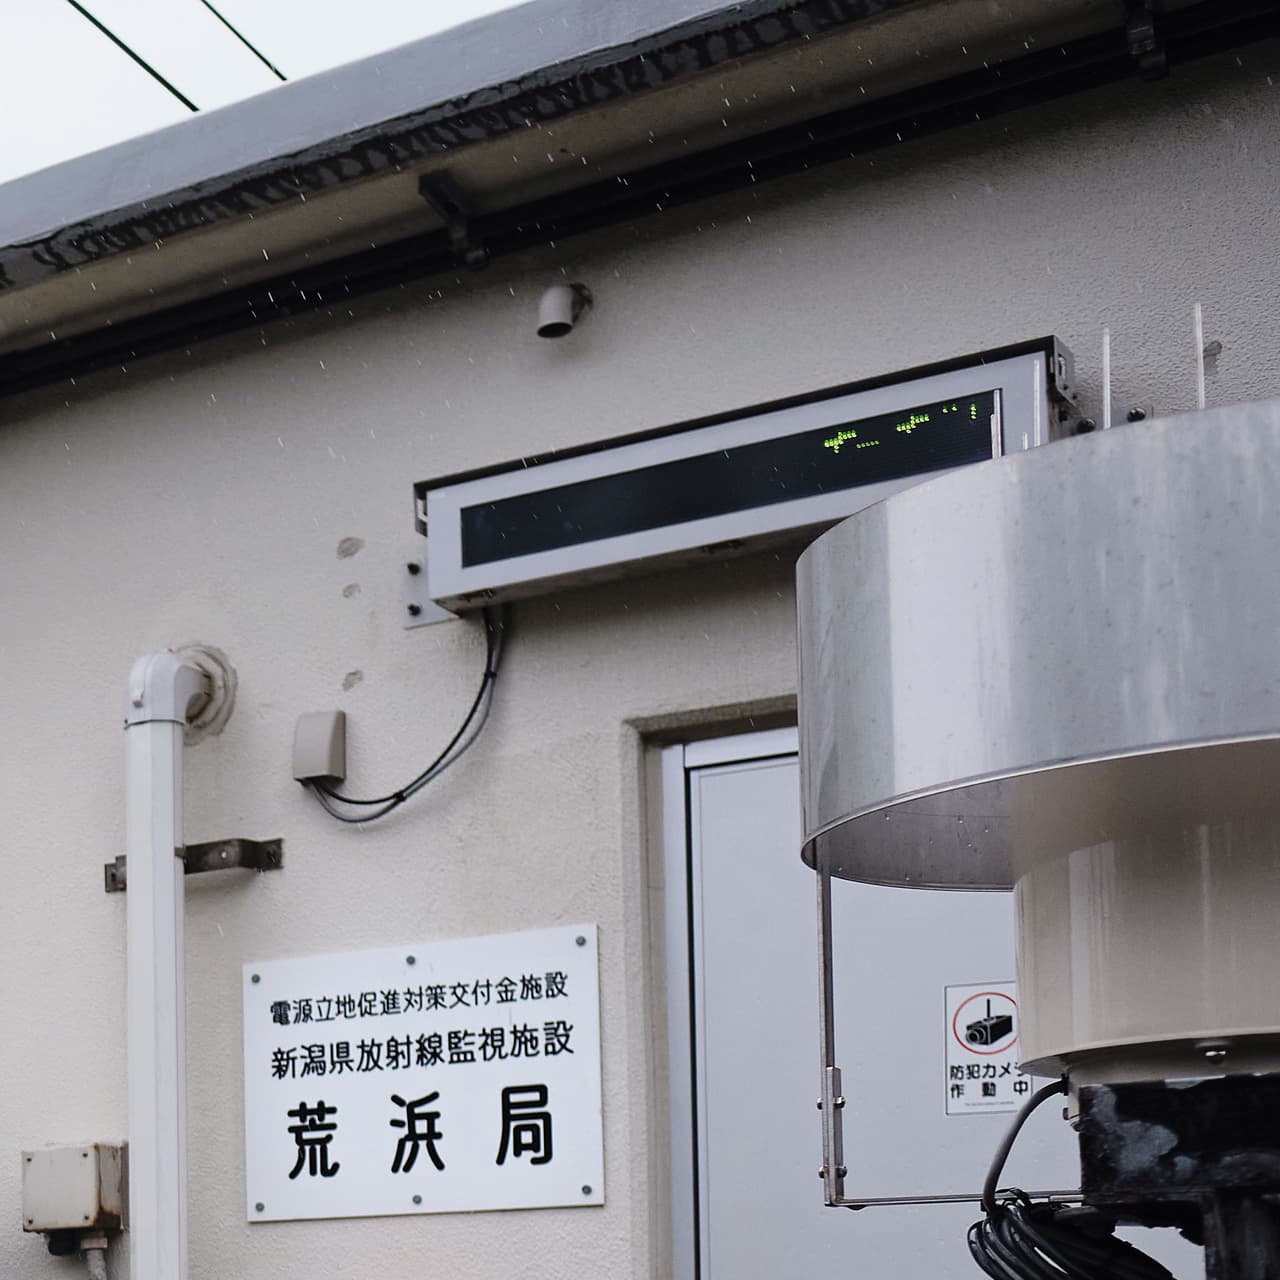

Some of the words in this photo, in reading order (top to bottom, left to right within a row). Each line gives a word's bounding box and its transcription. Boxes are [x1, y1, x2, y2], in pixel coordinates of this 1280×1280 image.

[270, 971, 569, 1026] 電源立地促進対策交付金施設
[271, 1020, 575, 1080] 新潟県放射線監視施設
[950, 1080, 1028, 1099] 作動中
[287, 1083, 554, 1179] 荒浜局
